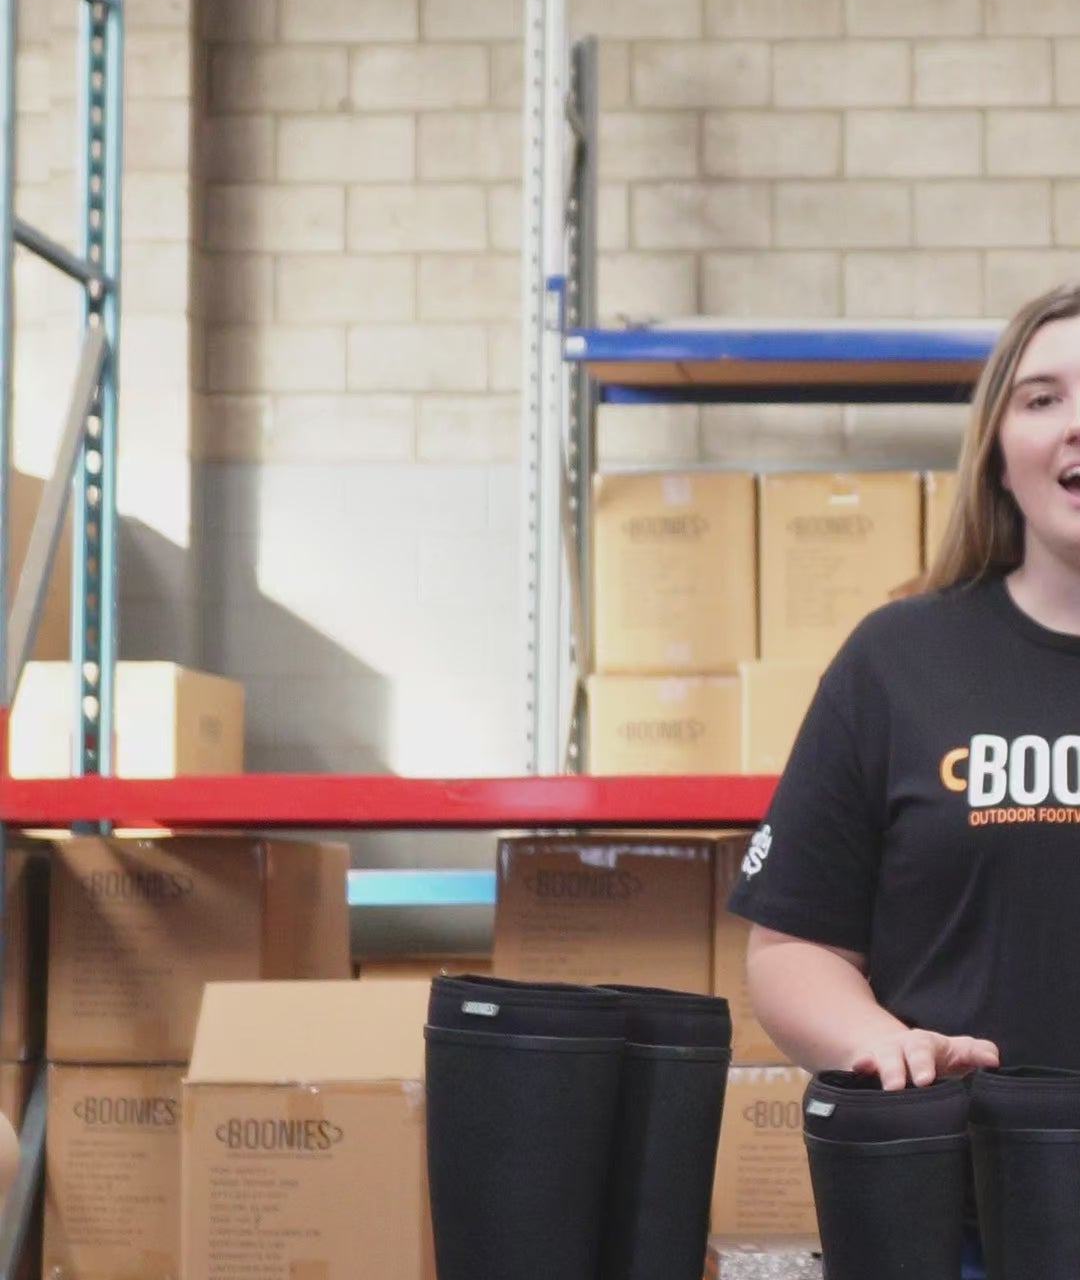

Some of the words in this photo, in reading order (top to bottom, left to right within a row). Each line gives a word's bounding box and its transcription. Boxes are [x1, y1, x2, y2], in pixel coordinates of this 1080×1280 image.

[969, 808, 1036, 826] OUTDOOR
[85, 1096, 177, 1125] BOONIES
[228, 1118, 331, 1150] BOONIES
